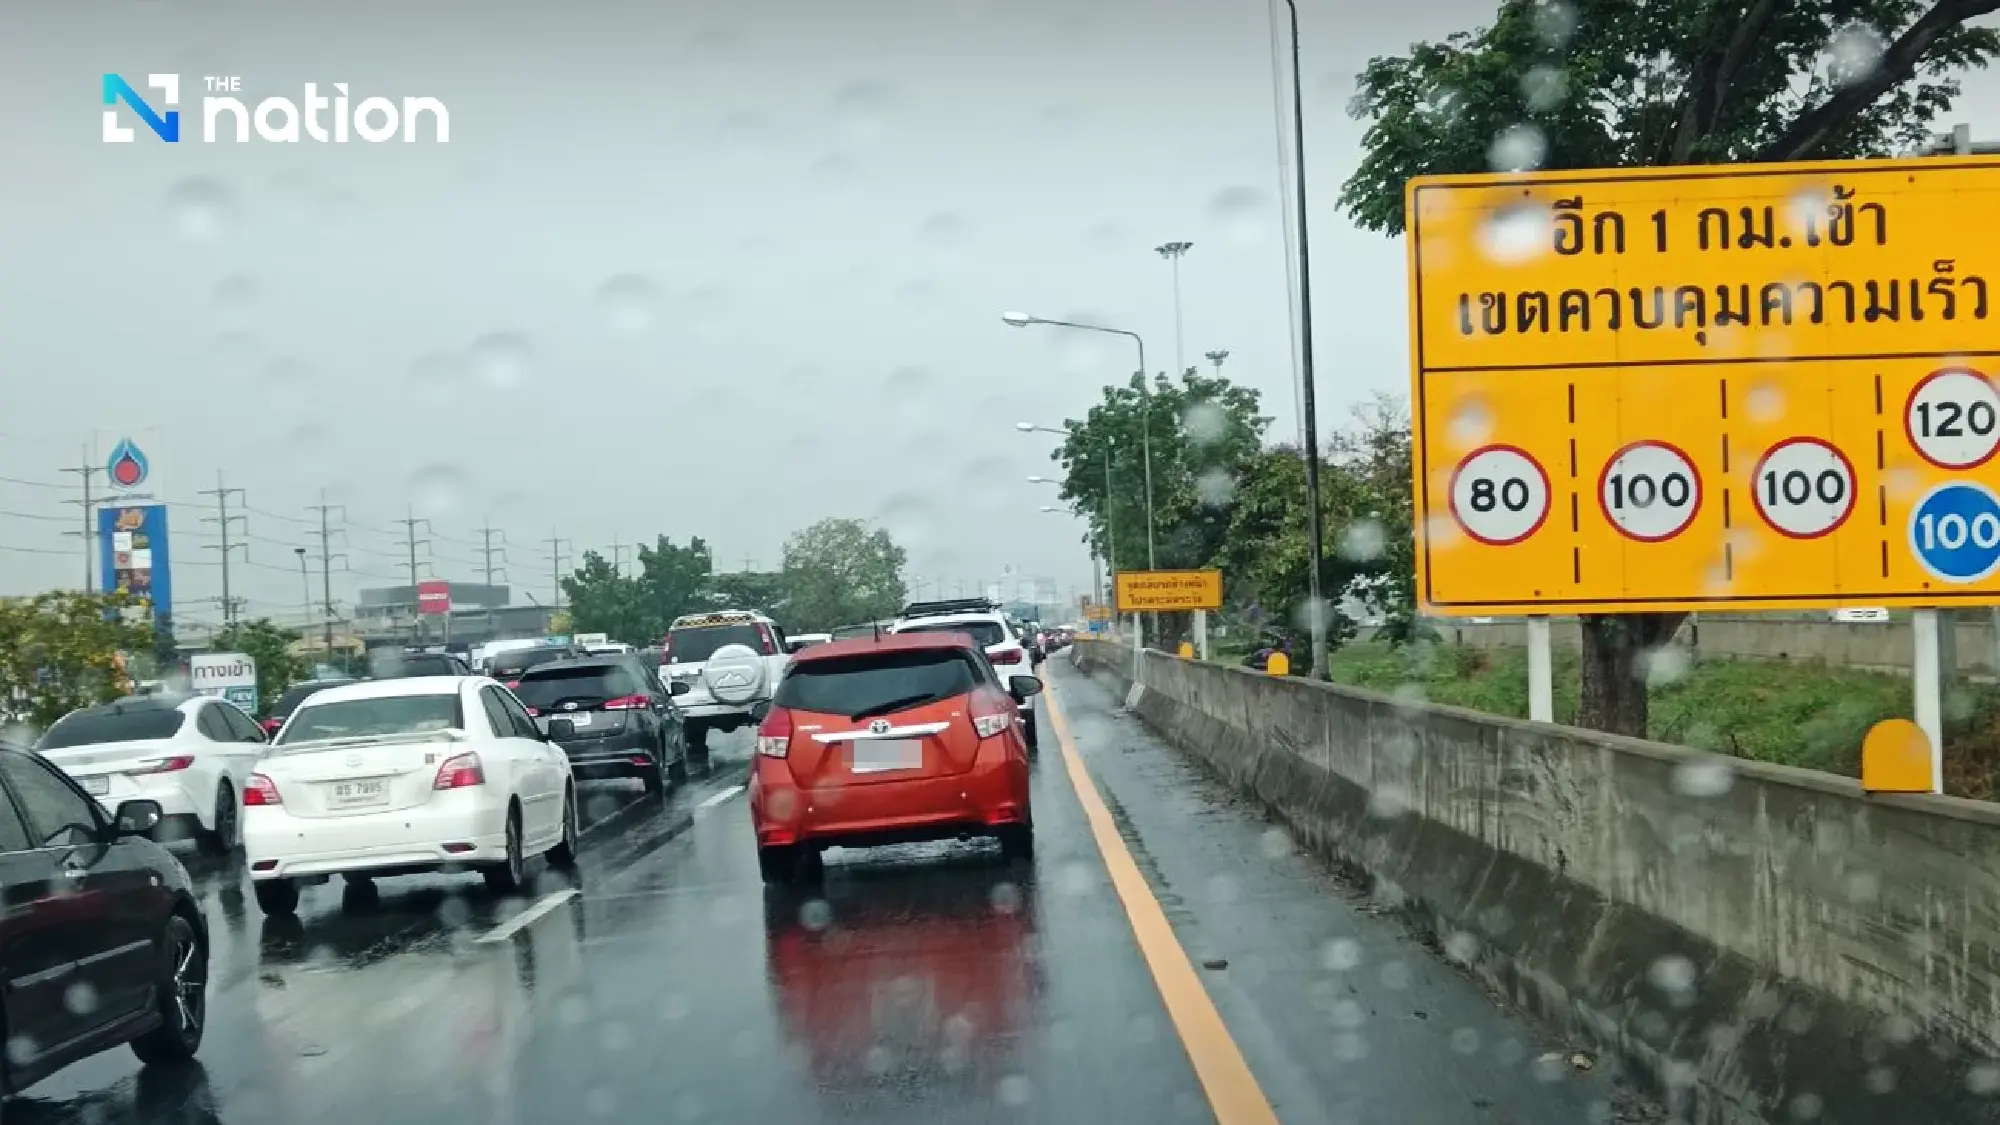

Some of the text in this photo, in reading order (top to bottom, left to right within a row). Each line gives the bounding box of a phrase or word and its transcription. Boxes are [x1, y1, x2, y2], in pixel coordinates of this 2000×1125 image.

[1552, 195, 1626, 255] อีก
[1651, 208, 1667, 253] 1
[1459, 259, 1989, 347] เขตควบคุมความเร็ว
[1917, 401, 1996, 438] 120
[1470, 478, 1529, 512] 80
[1609, 473, 1690, 510] 100
[1764, 468, 1845, 506] 100
[1919, 512, 2000, 550] 100
[194, 659, 253, 680] ทางเข้า
